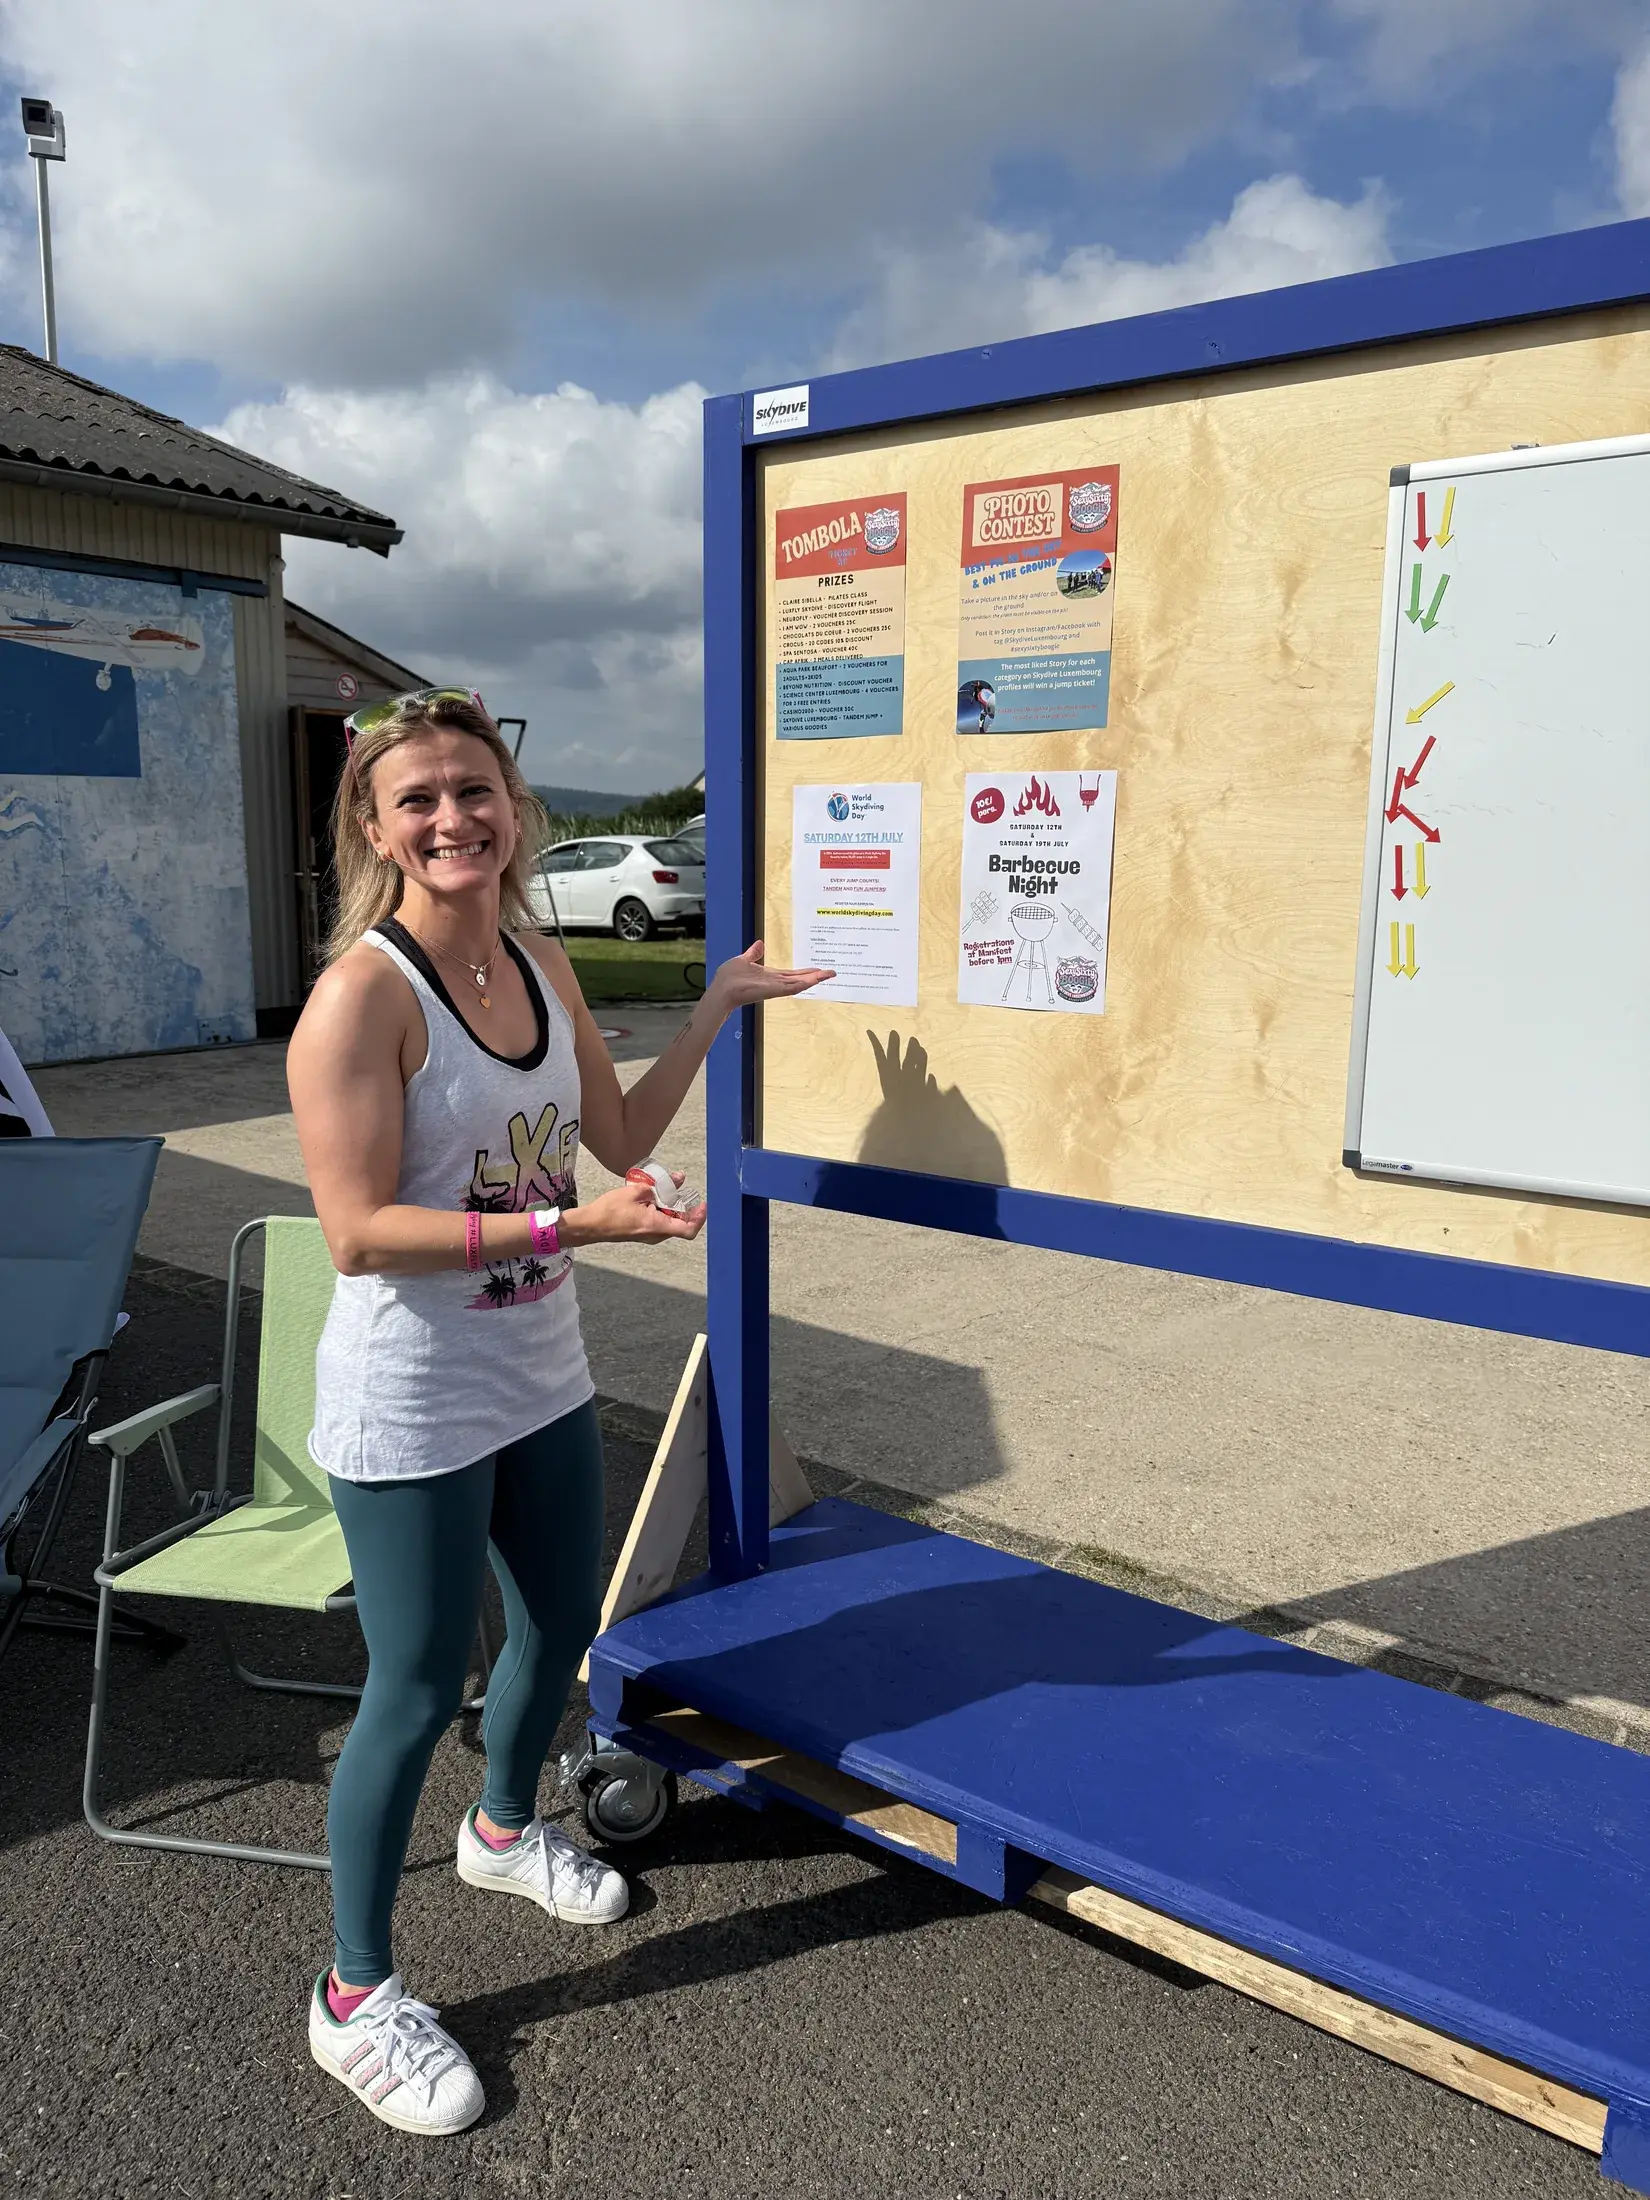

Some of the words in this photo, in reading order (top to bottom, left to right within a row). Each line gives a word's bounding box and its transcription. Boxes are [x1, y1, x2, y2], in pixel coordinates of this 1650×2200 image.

[756, 399, 807, 421] SKYDIVE
[984, 490, 1051, 519] PHOTO
[1072, 502, 1108, 517] BOOGIE
[980, 512, 1055, 542] CONTEST
[782, 512, 863, 563] TOMBOLA
[965, 562, 986, 576] BEST
[972, 579, 980, 589] &
[983, 574, 996, 586] ON
[999, 568, 1017, 581] THE
[1020, 558, 1058, 575] GROUND
[818, 574, 854, 588] PRIZES
[828, 602, 857, 610] DISCOVERY
[980, 595, 1000, 606] picture
[1004, 603, 1025, 611] ground
[839, 610, 868, 618] DISCOVERY
[783, 632, 814, 640] CHOCOLATS
[851, 626, 880, 634] VOUCHERS
[1001, 628, 1016, 636] Story
[1026, 623, 1086, 633] Instagram/Facebook
[1004, 634, 1068, 645] @SkydiveLuxembourg
[848, 662, 876, 670] VOUCHERS
[1032, 661, 1048, 669] liked
[1049, 660, 1067, 669] Story
[1080, 658, 1096, 666] each
[994, 673, 1022, 682] category
[1033, 671, 1058, 681] Skydive
[1060, 668, 1102, 677] Luxembourg
[998, 683, 1022, 693] profiles
[1023, 682, 1035, 690] will
[1054, 681, 1073, 690] jump
[1074, 679, 1096, 687] ticket!
[826, 688, 860, 696] LUXEMBOURG
[852, 803, 885, 812] Skydiving
[852, 813, 865, 821] Day
[804, 833, 853, 843] SATURDAY
[856, 833, 879, 843] 12TH
[880, 833, 904, 843] JULY
[989, 854, 1080, 875] Barbecue
[1009, 875, 1058, 898] Night
[964, 940, 1015, 951] Registrations
[978, 947, 1012, 957] Manifest
[969, 958, 994, 966] before
[997, 956, 1012, 965] 1pm
[1060, 976, 1095, 986] BOOGIE
[1363, 1159, 1399, 1169] Legamaster
